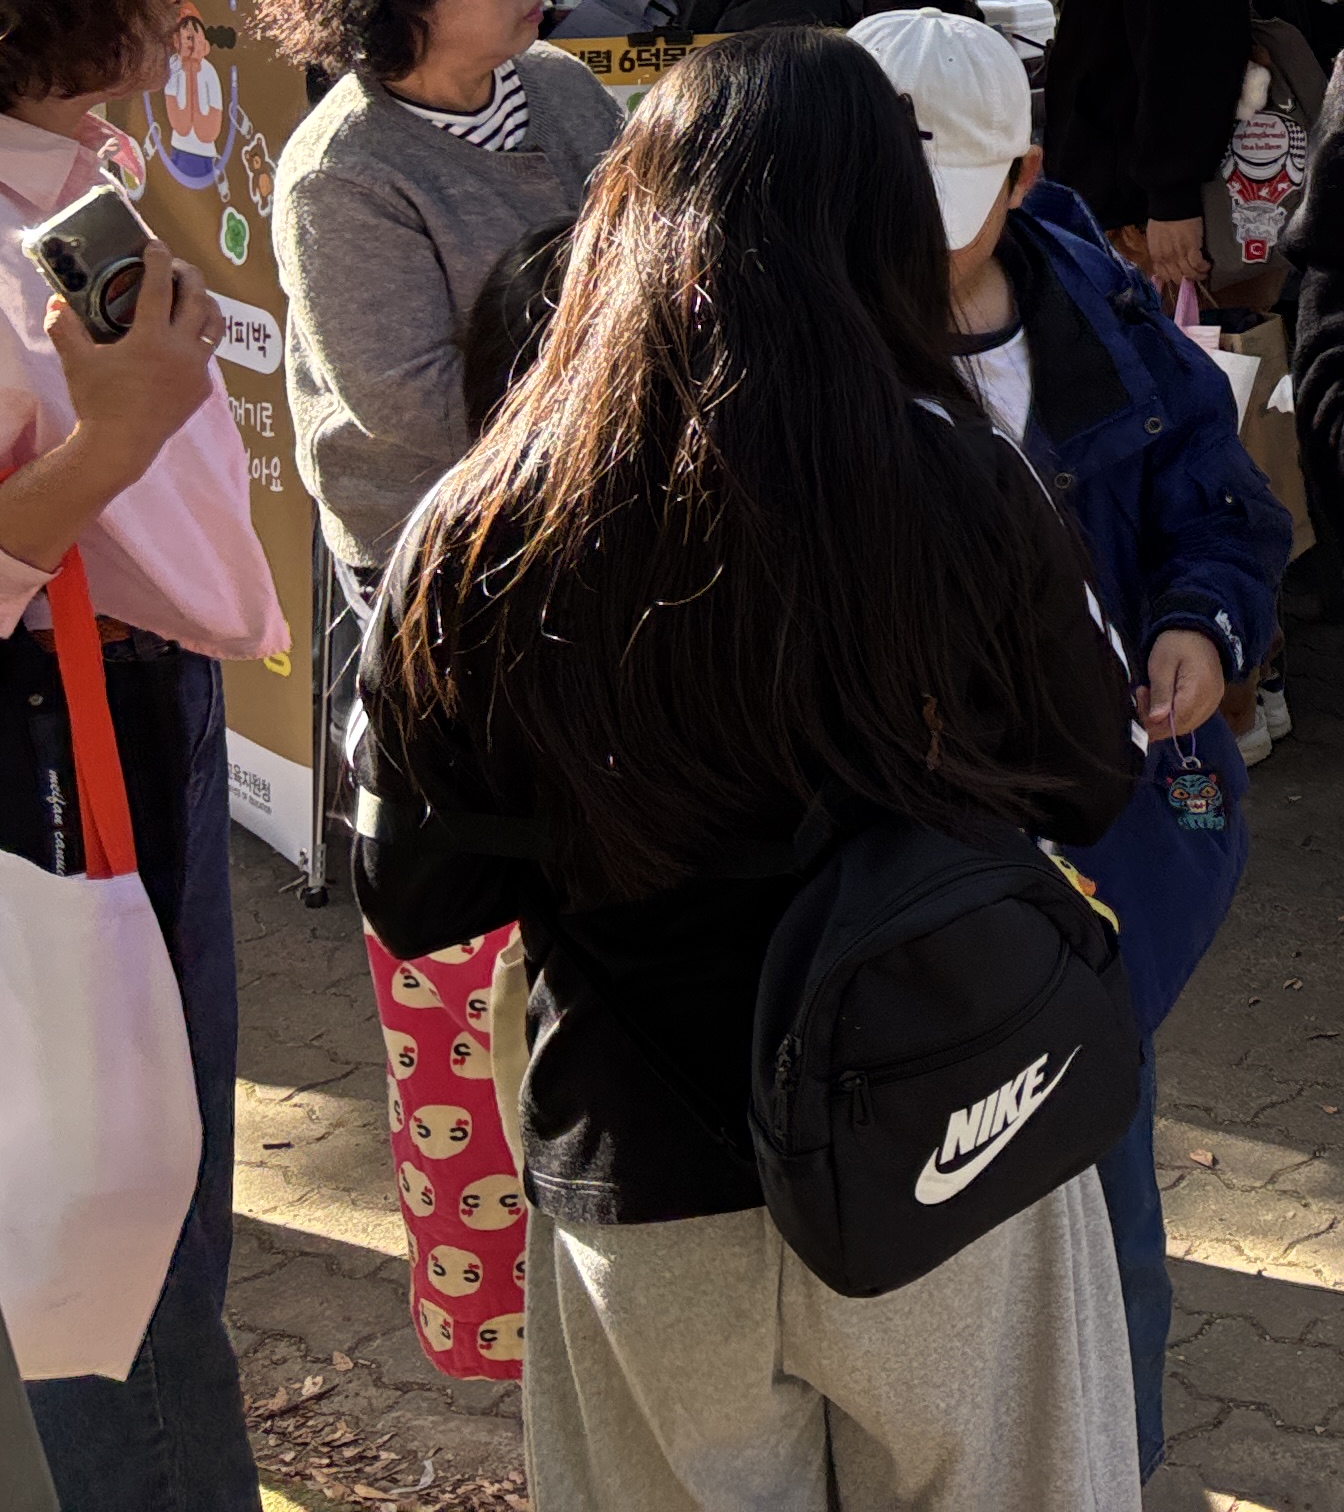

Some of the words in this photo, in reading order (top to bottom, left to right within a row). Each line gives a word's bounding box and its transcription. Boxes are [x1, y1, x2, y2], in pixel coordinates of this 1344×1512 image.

[619, 47, 703, 74] 6덕목
[245, 446, 284, 493] 아요
[938, 1052, 1050, 1166] NIKE
